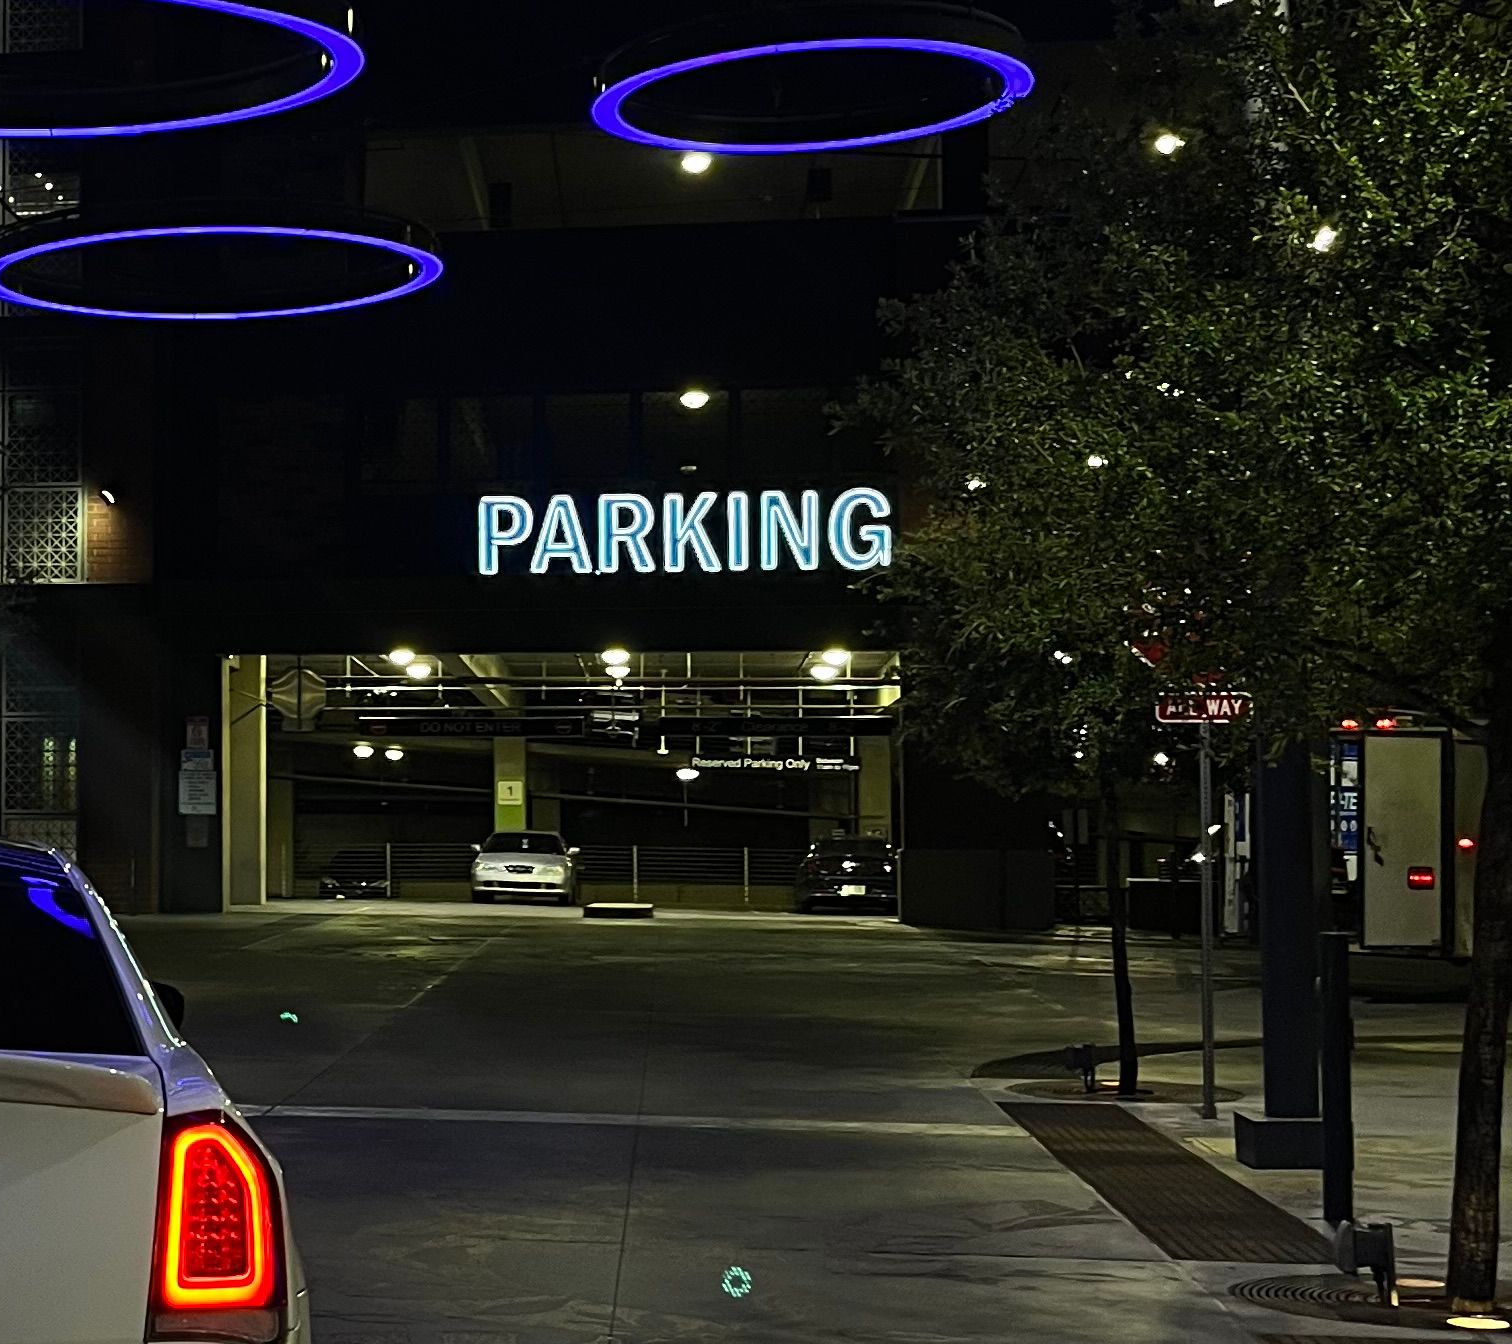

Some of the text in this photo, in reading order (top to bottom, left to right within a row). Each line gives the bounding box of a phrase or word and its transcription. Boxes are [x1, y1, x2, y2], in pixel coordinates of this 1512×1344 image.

[478, 487, 892, 575] PARKING
[1206, 699, 1243, 715] WAY
[419, 721, 522, 733] DO NOT ENTER
[692, 757, 741, 768] Reserved
[744, 758, 783, 770] Parking
[785, 758, 811, 771] Only
[506, 786, 514, 796] 1
